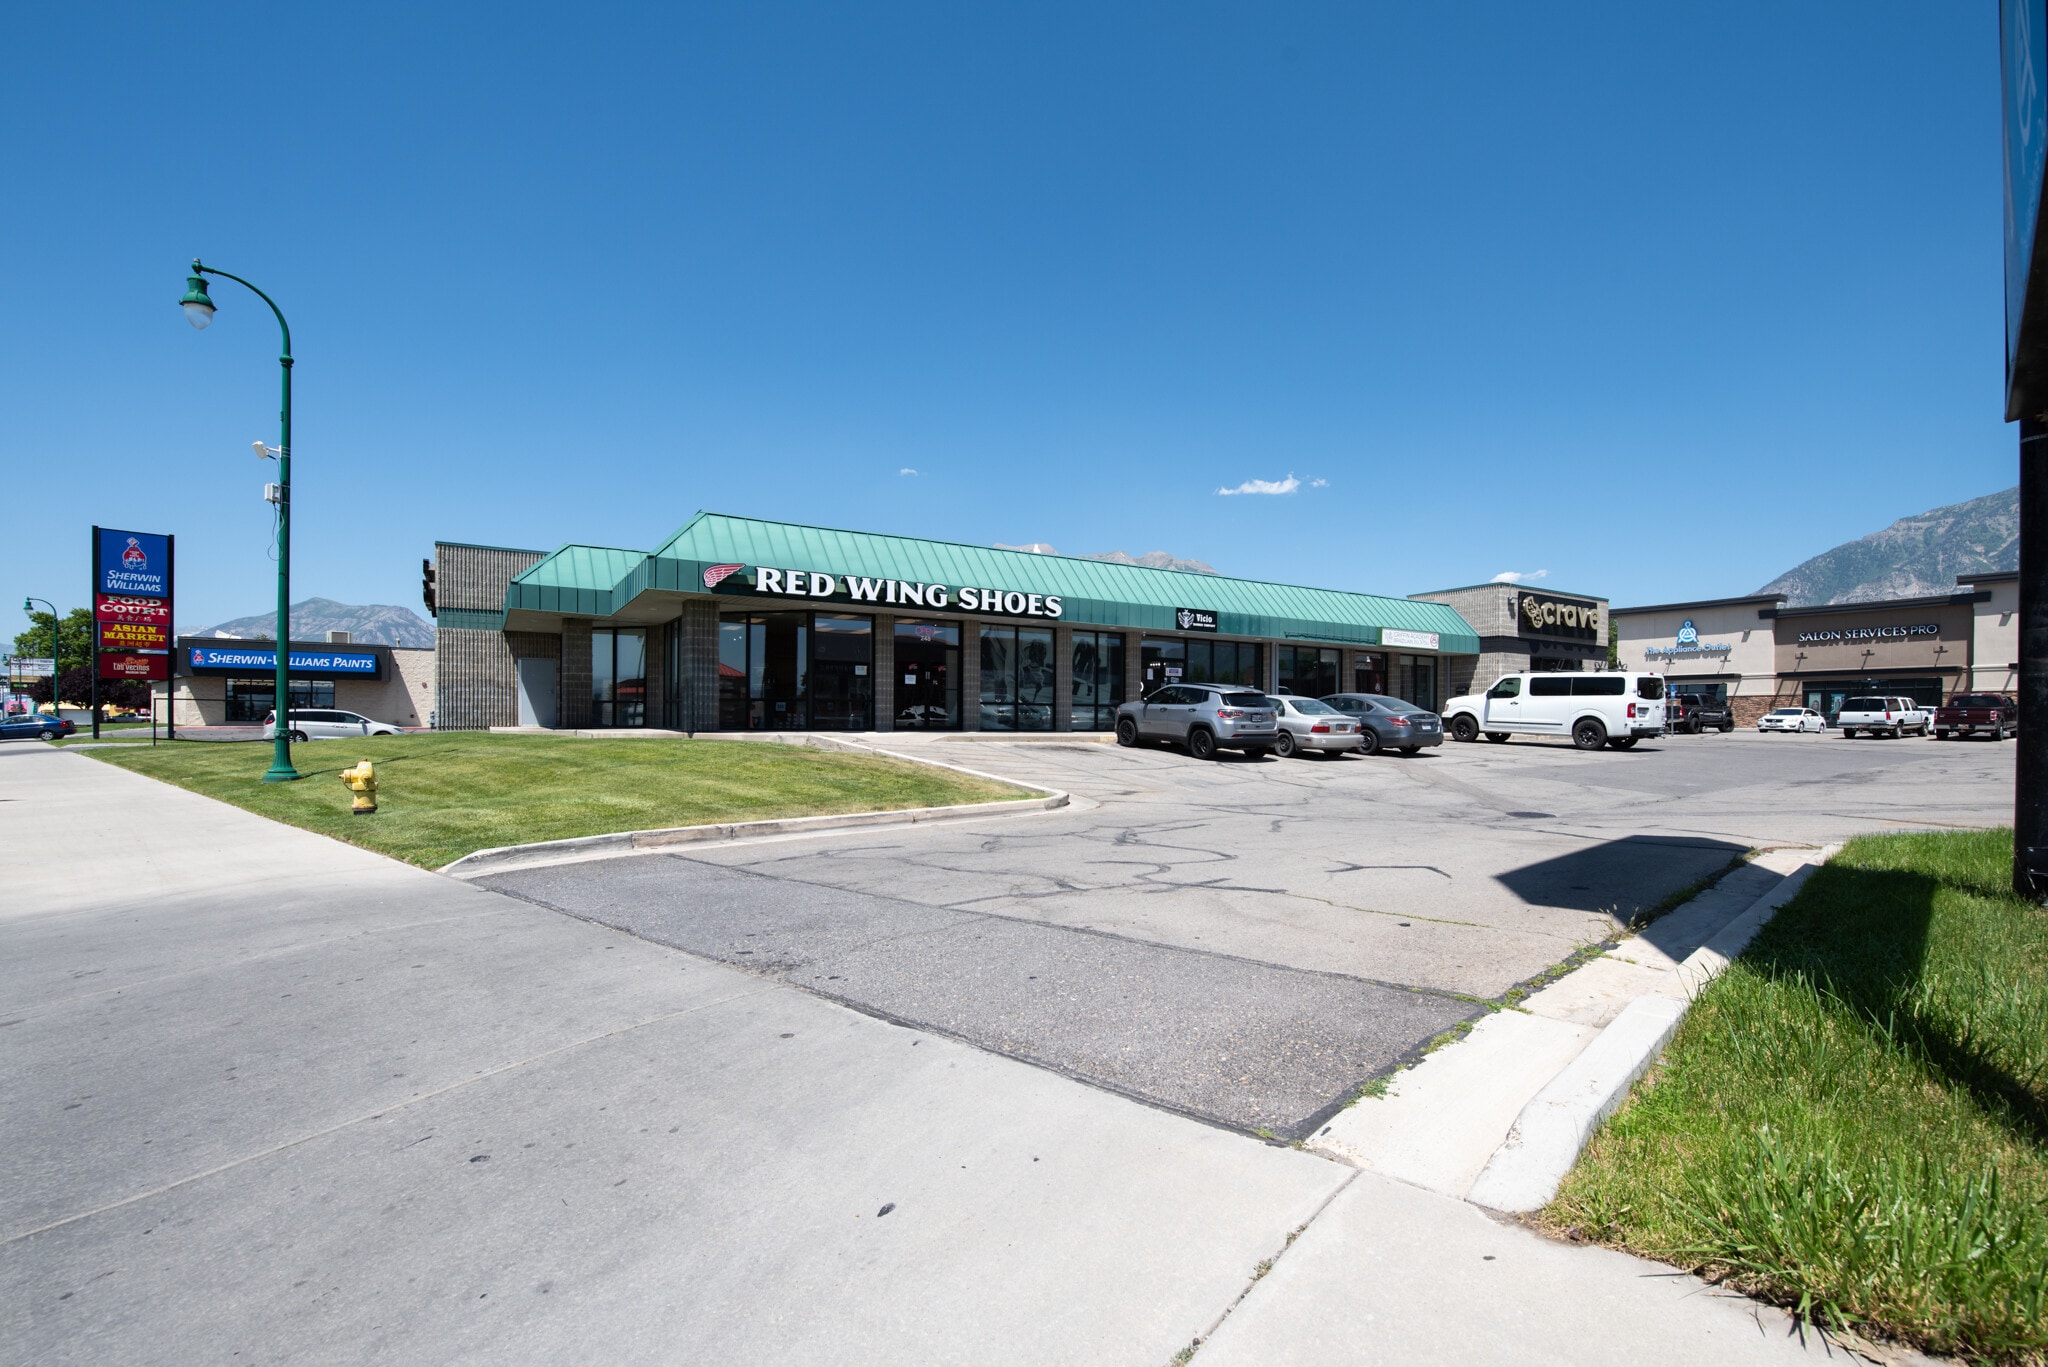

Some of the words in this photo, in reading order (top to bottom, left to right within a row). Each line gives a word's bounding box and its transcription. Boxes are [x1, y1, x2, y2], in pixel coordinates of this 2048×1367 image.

[107, 569, 161, 583] SHERWIN
[107, 579, 162, 592] WILLIAMS
[755, 565, 836, 597] RED
[843, 574, 949, 608] WING
[958, 587, 1064, 618] SHOES
[107, 595, 162, 606] FOOD
[100, 604, 168, 616] COURT
[1541, 602, 1599, 630] crave
[112, 624, 157, 633] ASIAN
[1799, 631, 1841, 641] SALON
[1845, 626, 1907, 639] SERVICES
[1910, 625, 1938, 635] PRO
[104, 631, 166, 642] MARKET
[1645, 646, 1660, 655] The
[1662, 645, 1702, 655] Appliance
[1704, 643, 1732, 651] Outlet
[208, 652, 330, 667] SHERWIN-LLIAMS
[332, 657, 373, 669] PAINTS
